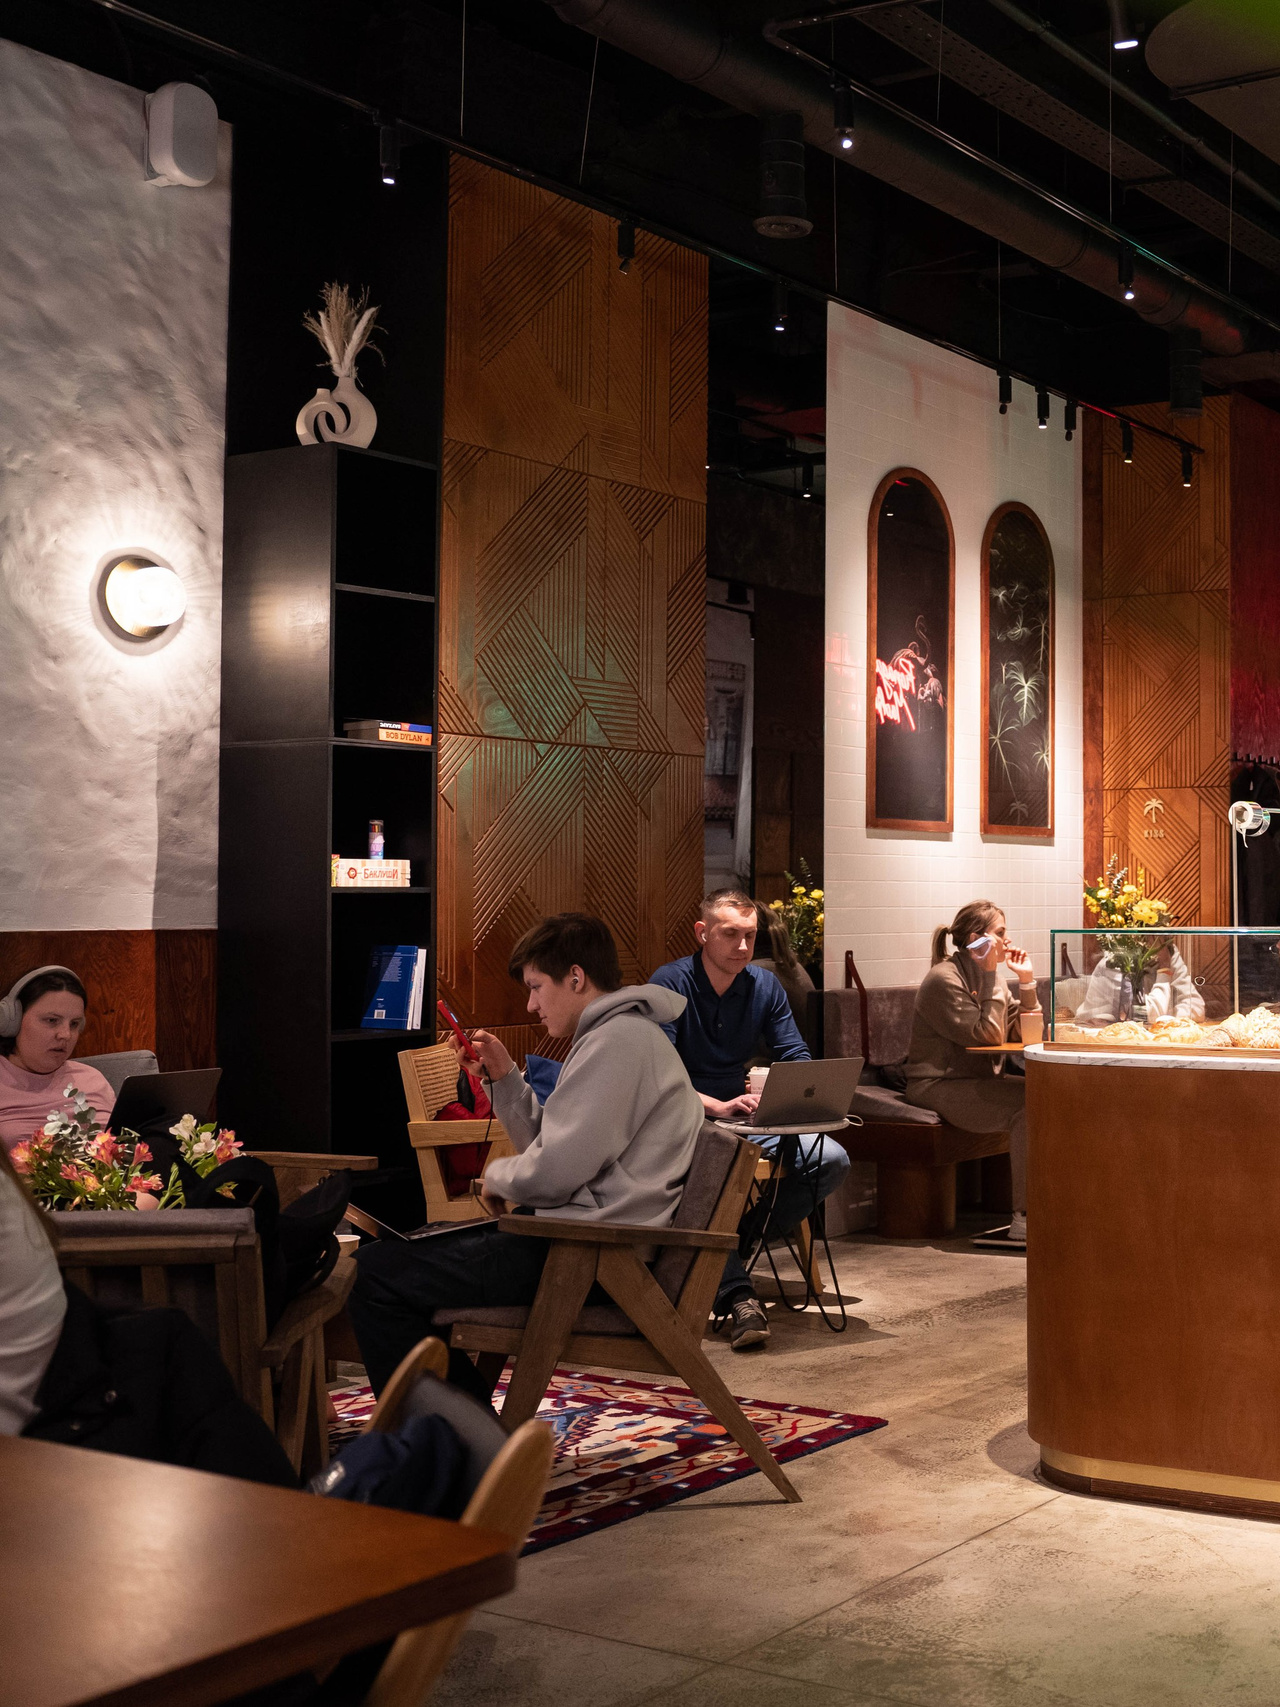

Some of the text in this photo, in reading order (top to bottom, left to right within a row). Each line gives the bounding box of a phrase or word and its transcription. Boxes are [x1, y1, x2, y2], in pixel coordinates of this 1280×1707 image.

[385, 731, 423, 742] BOB DYLAN
[1143, 829, 1165, 839] KISS
